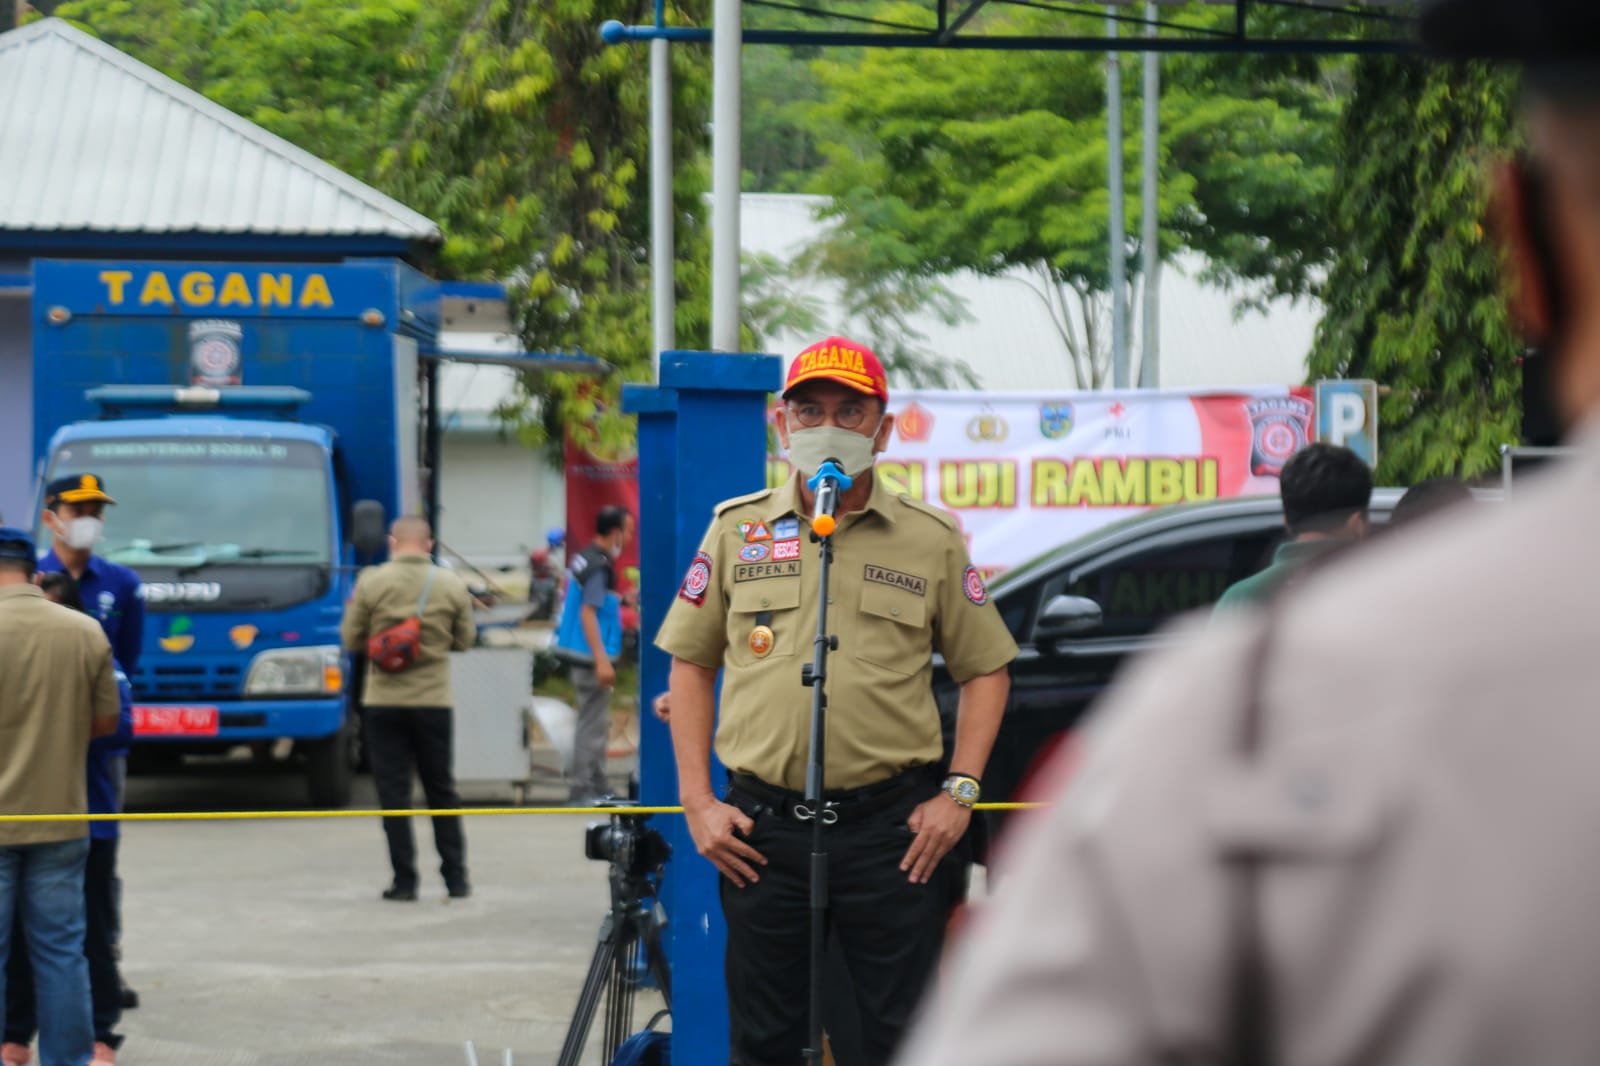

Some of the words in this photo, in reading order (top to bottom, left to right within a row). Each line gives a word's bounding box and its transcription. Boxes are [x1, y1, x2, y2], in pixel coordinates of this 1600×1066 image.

[101, 271, 333, 306] TAGANA
[799, 345, 867, 374] TAGANA
[1252, 398, 1306, 414] TAGANA
[1331, 392, 1366, 447] P
[941, 461, 1017, 508] UJI
[1031, 458, 1220, 507] RAMBU
[774, 540, 799, 558] RESCUE
[739, 564, 784, 579] PEPEN.
[788, 563, 797, 573] N
[868, 567, 922, 592] TAGANA
[135, 582, 221, 601] ISUZU
